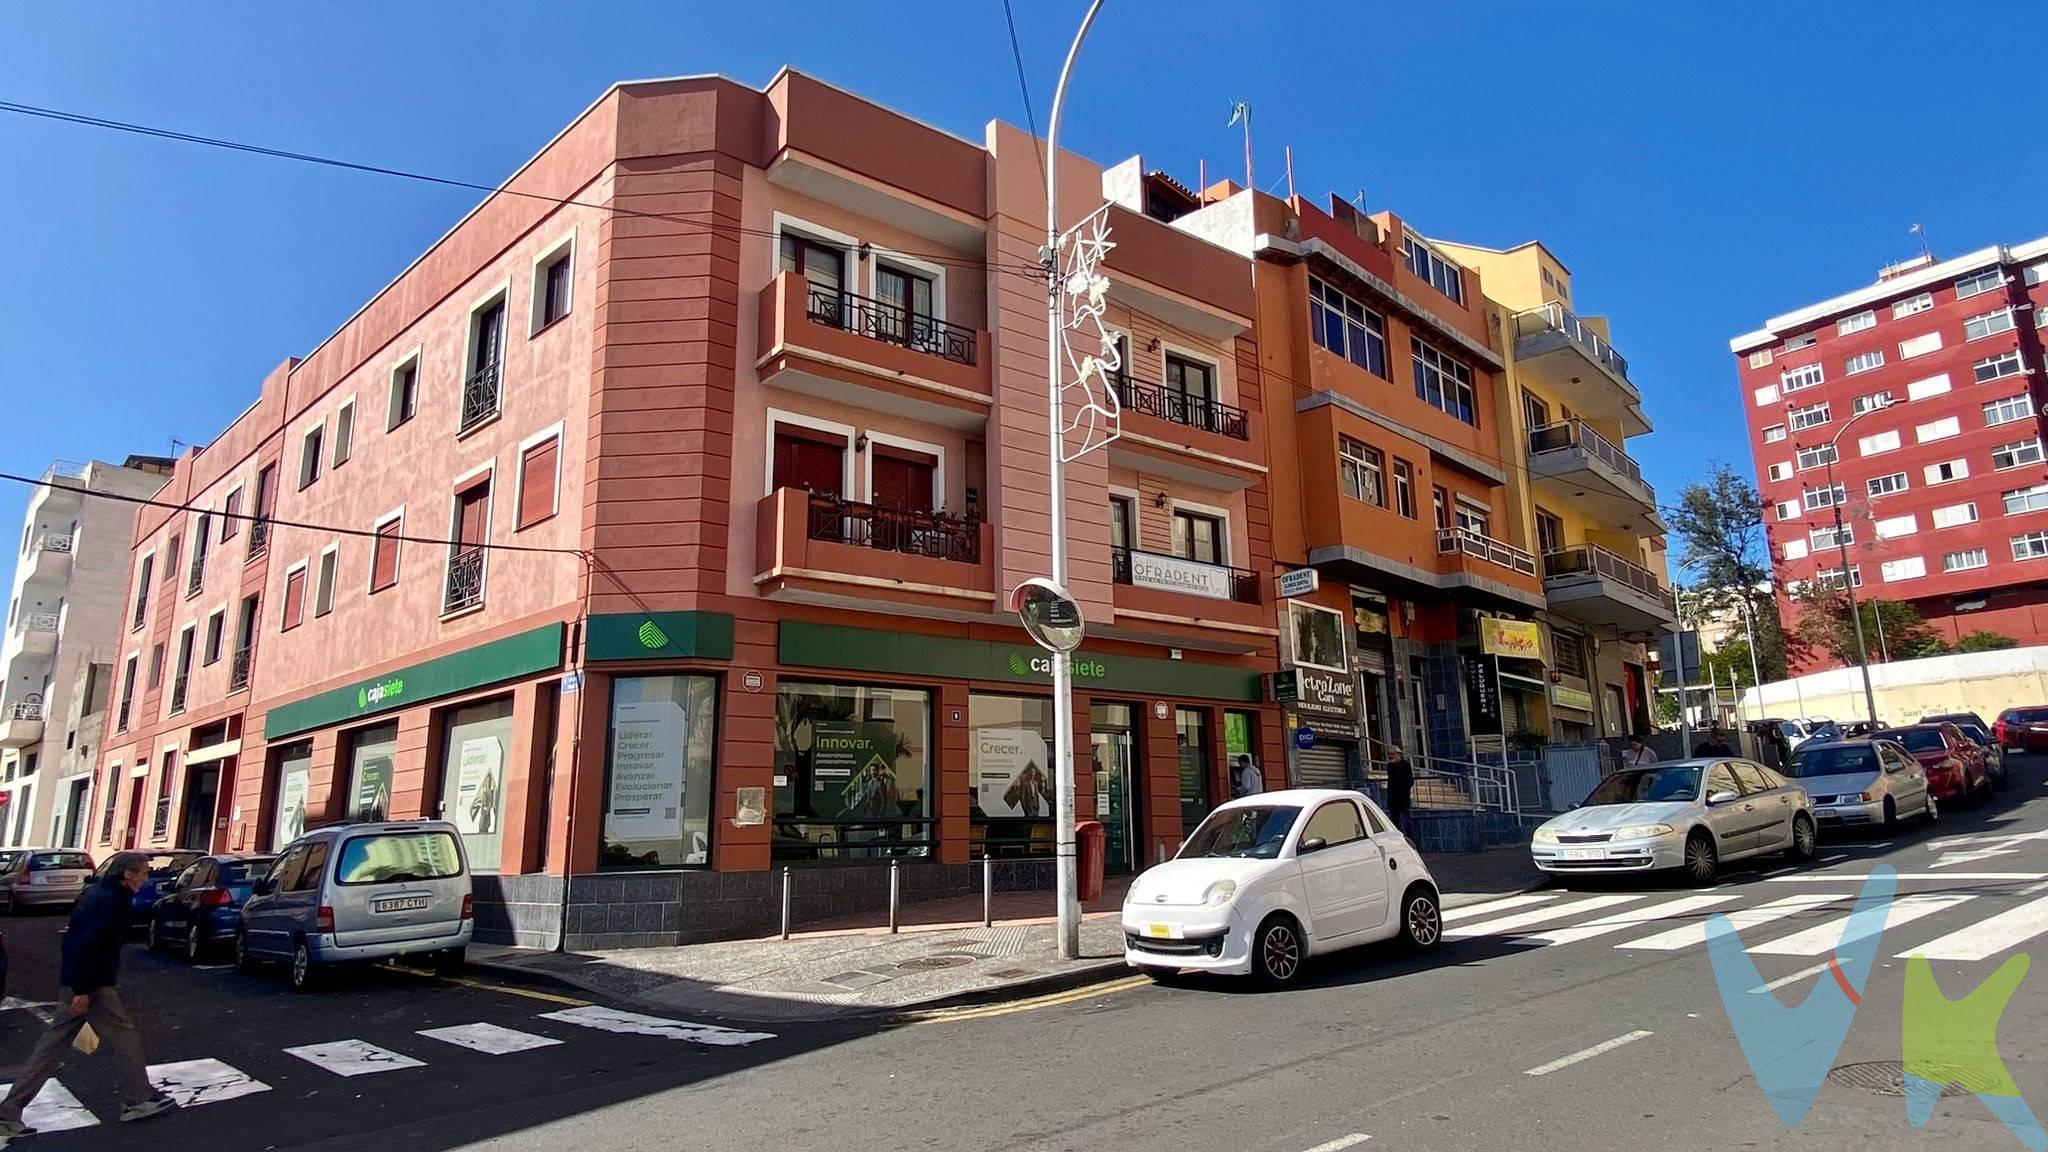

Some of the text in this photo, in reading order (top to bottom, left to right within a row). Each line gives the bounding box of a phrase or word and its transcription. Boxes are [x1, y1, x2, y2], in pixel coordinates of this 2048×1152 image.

[1134, 563, 1208, 585] OFRADENT
[1281, 570, 1310, 583] OFRADENT
[1030, 656, 1105, 677] cajsiete
[367, 678, 404, 704] cajasiete
[618, 731, 656, 740] Liderar.
[617, 741, 653, 750] Crecer.
[815, 734, 874, 749] Innovar.
[980, 742, 1023, 754] Crecer.
[617, 751, 668, 761] Progresar.
[616, 762, 656, 770] Innovar.
[615, 772, 657, 781] Avanzar.
[615, 782, 676, 791] Evolucionar.
[614, 792, 665, 802] Prosperar.
